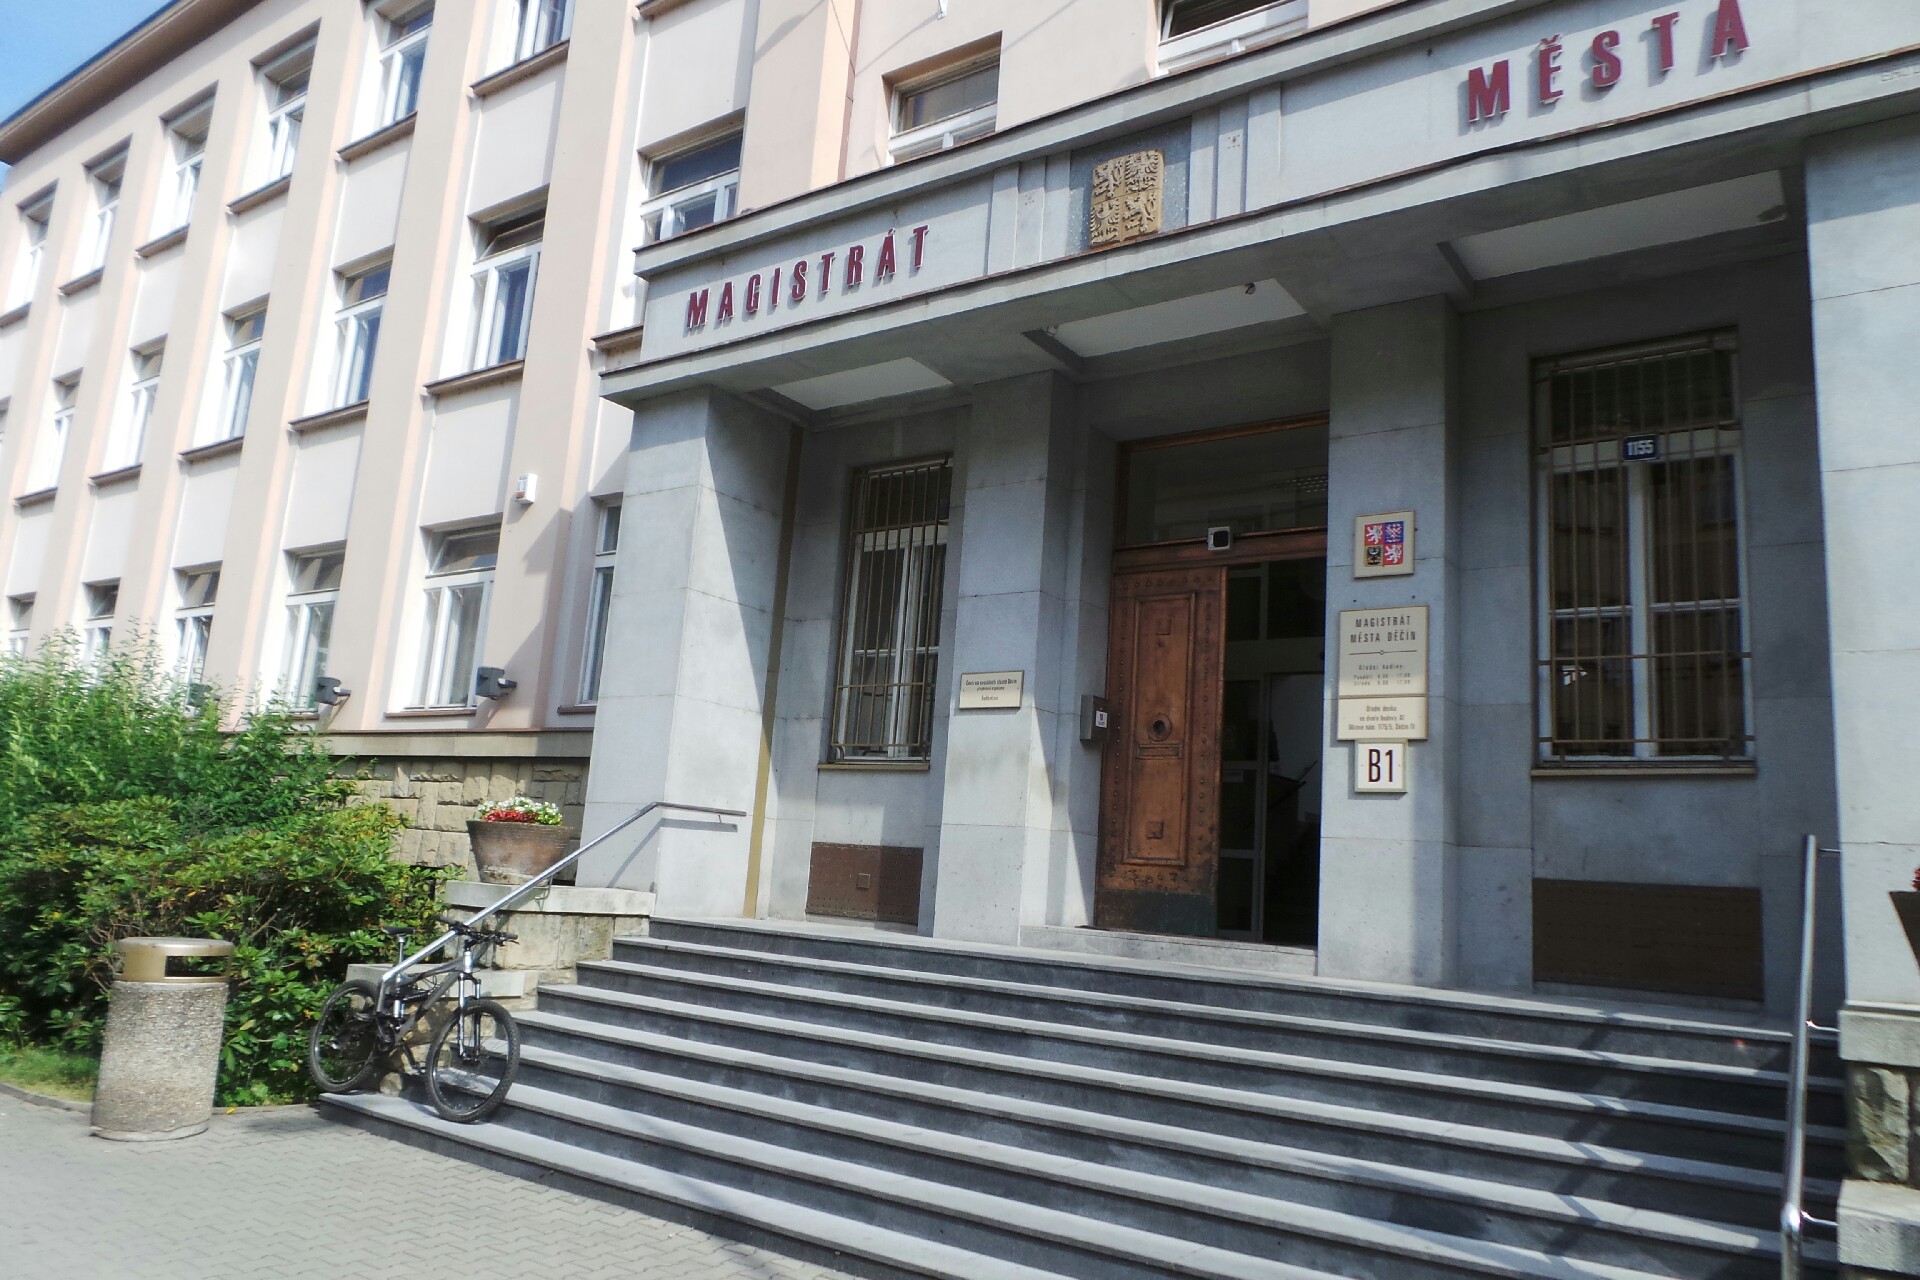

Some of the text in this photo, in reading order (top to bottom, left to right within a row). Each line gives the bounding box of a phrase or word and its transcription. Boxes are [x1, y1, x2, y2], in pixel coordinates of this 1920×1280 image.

[686, 0, 1750, 328] MAGISTRÁT MĚSTA
[1627, 440, 1654, 456] 1155
[1355, 614, 1411, 628] MAGISTRÁT
[1350, 629, 1416, 643] MĚSTA DĚČÍN
[1368, 748, 1394, 783] B1
